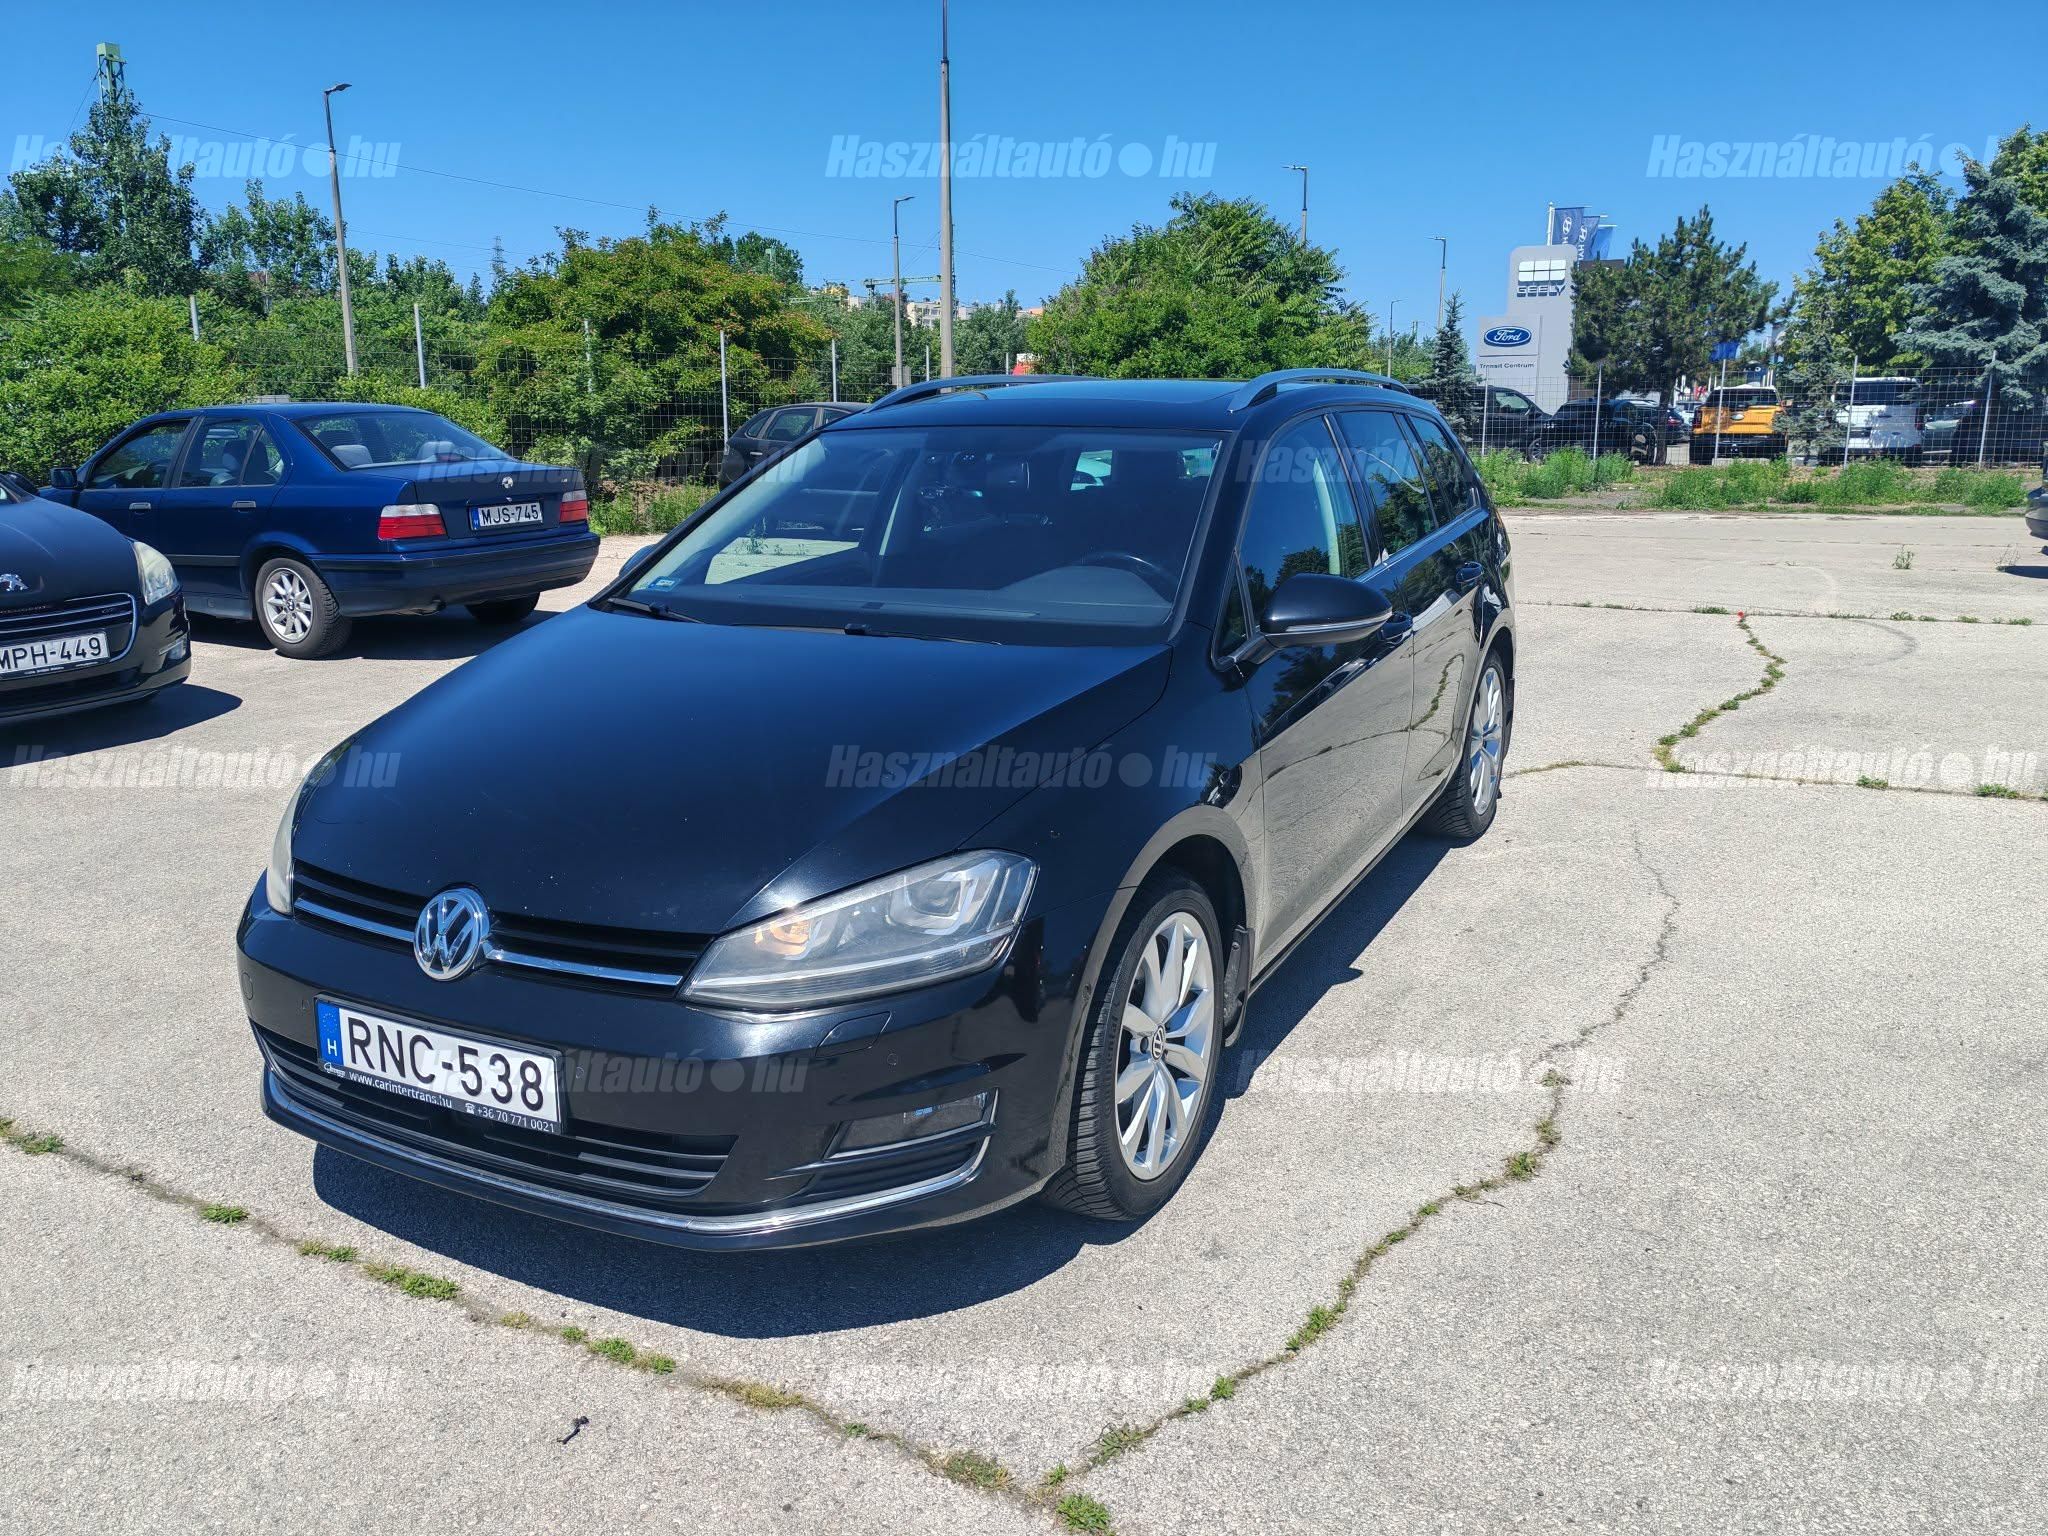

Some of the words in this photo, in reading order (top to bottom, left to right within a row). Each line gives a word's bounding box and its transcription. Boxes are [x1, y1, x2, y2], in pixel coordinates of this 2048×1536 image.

[1516, 285, 1566, 298] GEELY
[1493, 329, 1523, 342] Ford
[481, 504, 539, 525] MJS-745
[0, 637, 102, 670] MPH-449
[327, 1038, 338, 1056] H
[347, 1016, 544, 1112] RNC-538
[348, 1070, 453, 1109] www.carintertrans.hu
[496, 1110, 508, 1122] 70
[510, 1114, 527, 1128] 771
[530, 1119, 555, 1133] 0021
